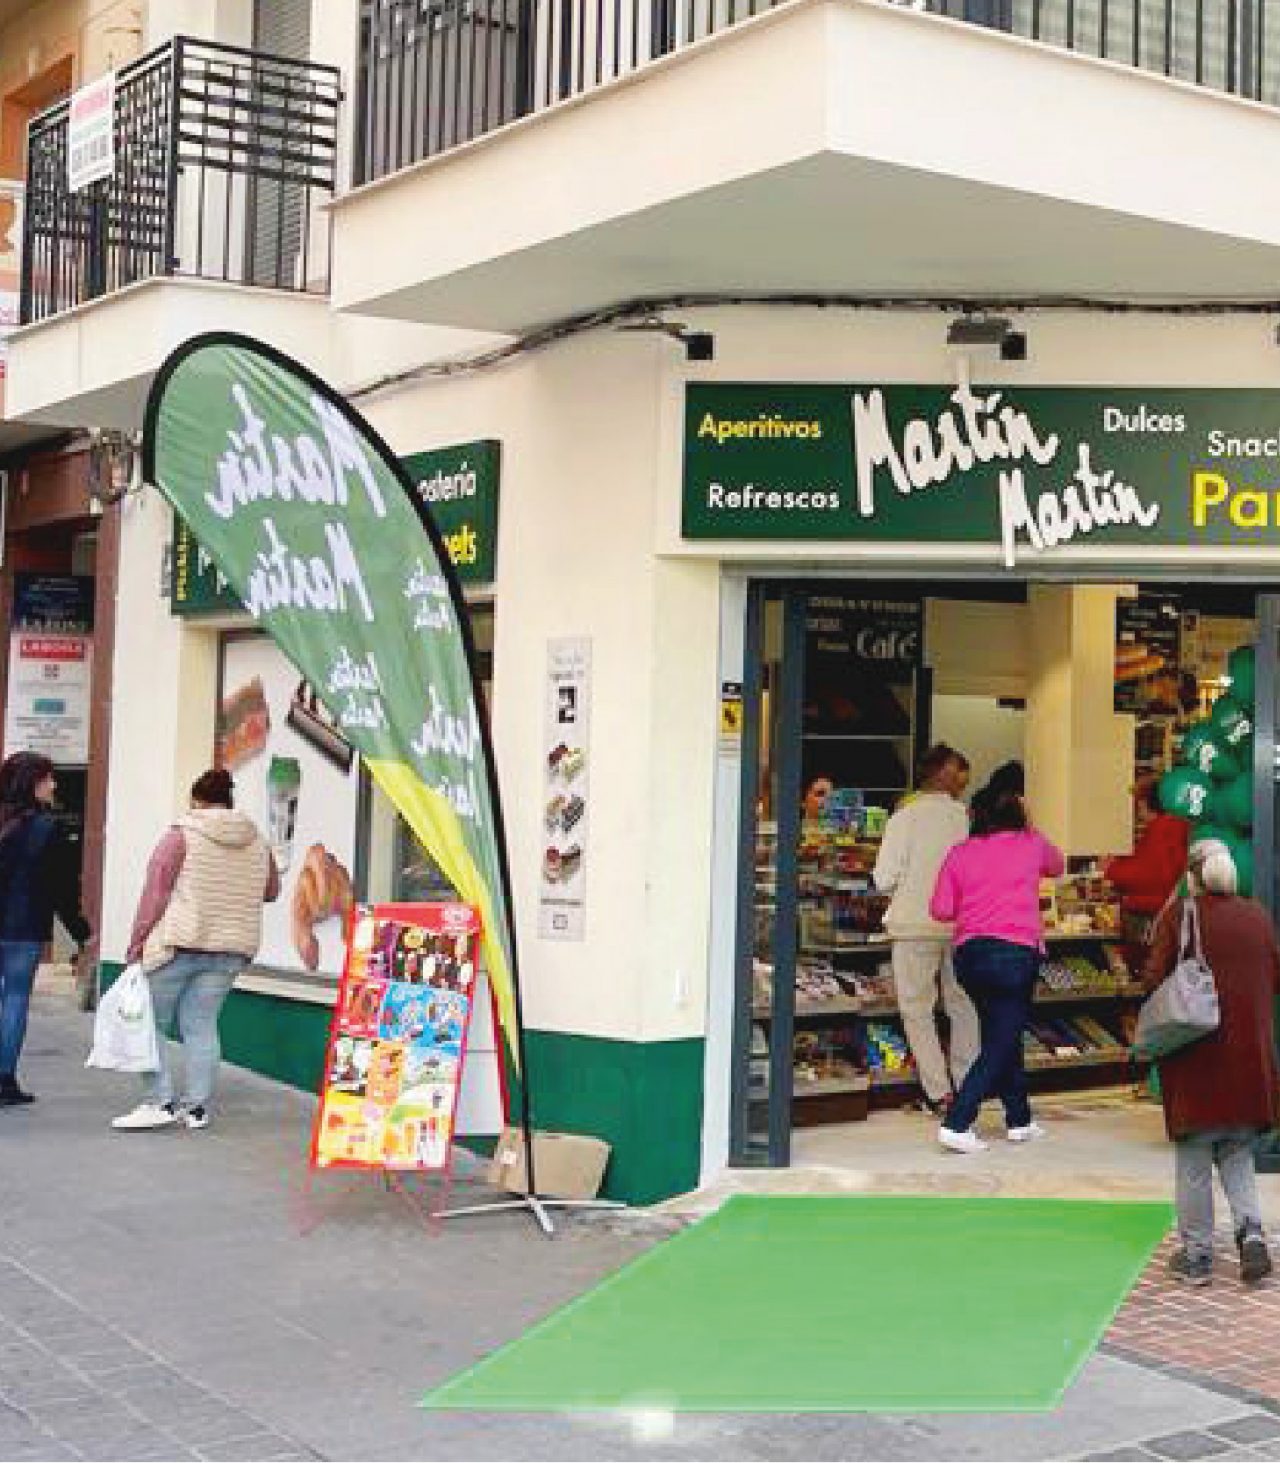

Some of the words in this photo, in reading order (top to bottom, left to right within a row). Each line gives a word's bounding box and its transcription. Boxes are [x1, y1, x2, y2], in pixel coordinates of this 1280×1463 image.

[698, 411, 822, 444] Aperitivos
[852, 356, 1059, 517] Martín
[1103, 405, 1187, 432] Dulces
[417, 461, 477, 501] ostería
[707, 482, 840, 508] Refrescos
[999, 443, 1160, 567] Martín
[443, 526, 477, 565] els
